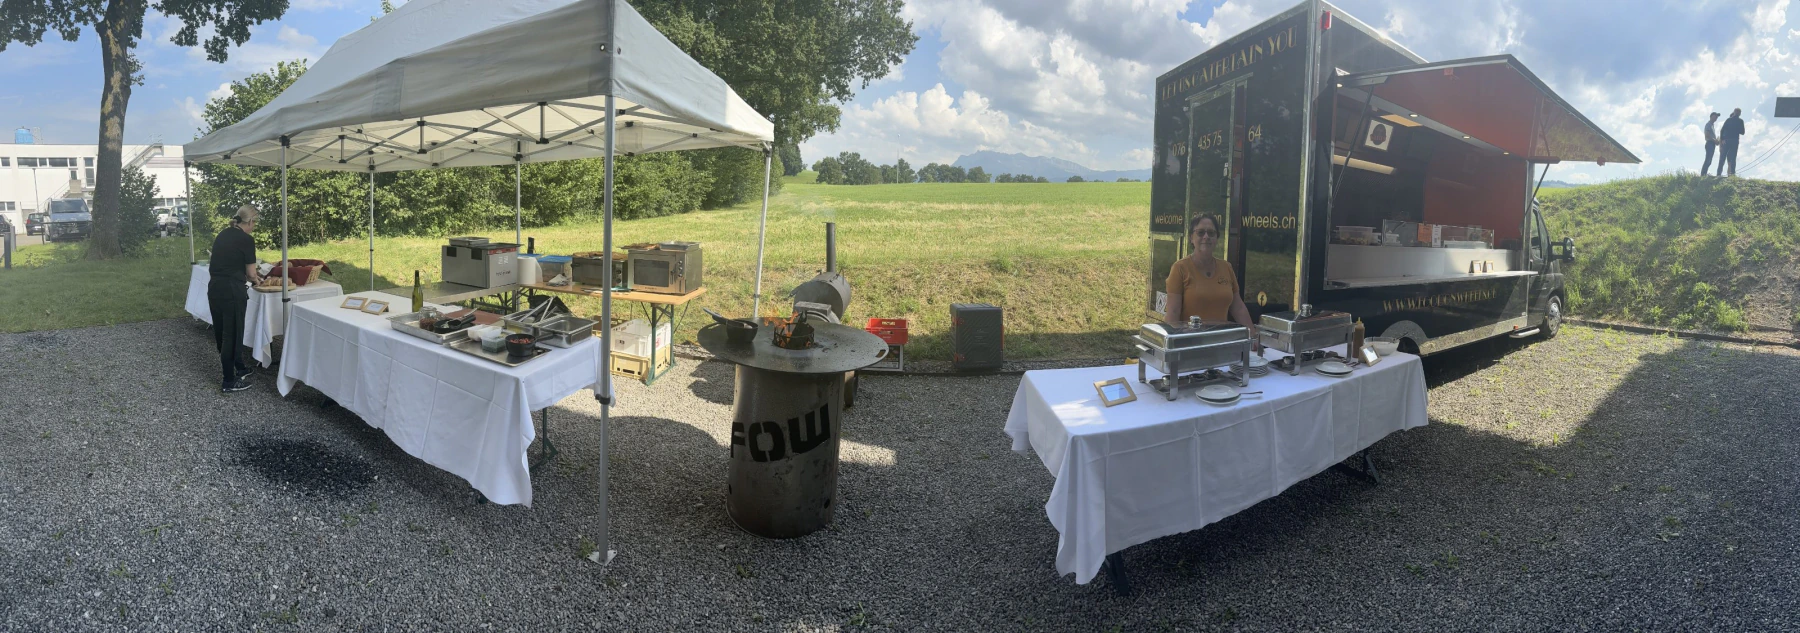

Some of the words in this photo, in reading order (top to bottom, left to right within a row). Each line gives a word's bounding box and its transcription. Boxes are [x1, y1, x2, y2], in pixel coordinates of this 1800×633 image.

[1268, 25, 1297, 56] YOU
[1172, 141, 1186, 156] 076
[1197, 133, 1211, 150] 435
[1213, 130, 1223, 146] 75
[1248, 124, 1262, 142] 64
[1154, 212, 1183, 225] welcome
[1242, 212, 1296, 229] wheels.ch
[731, 403, 831, 462] FOW
